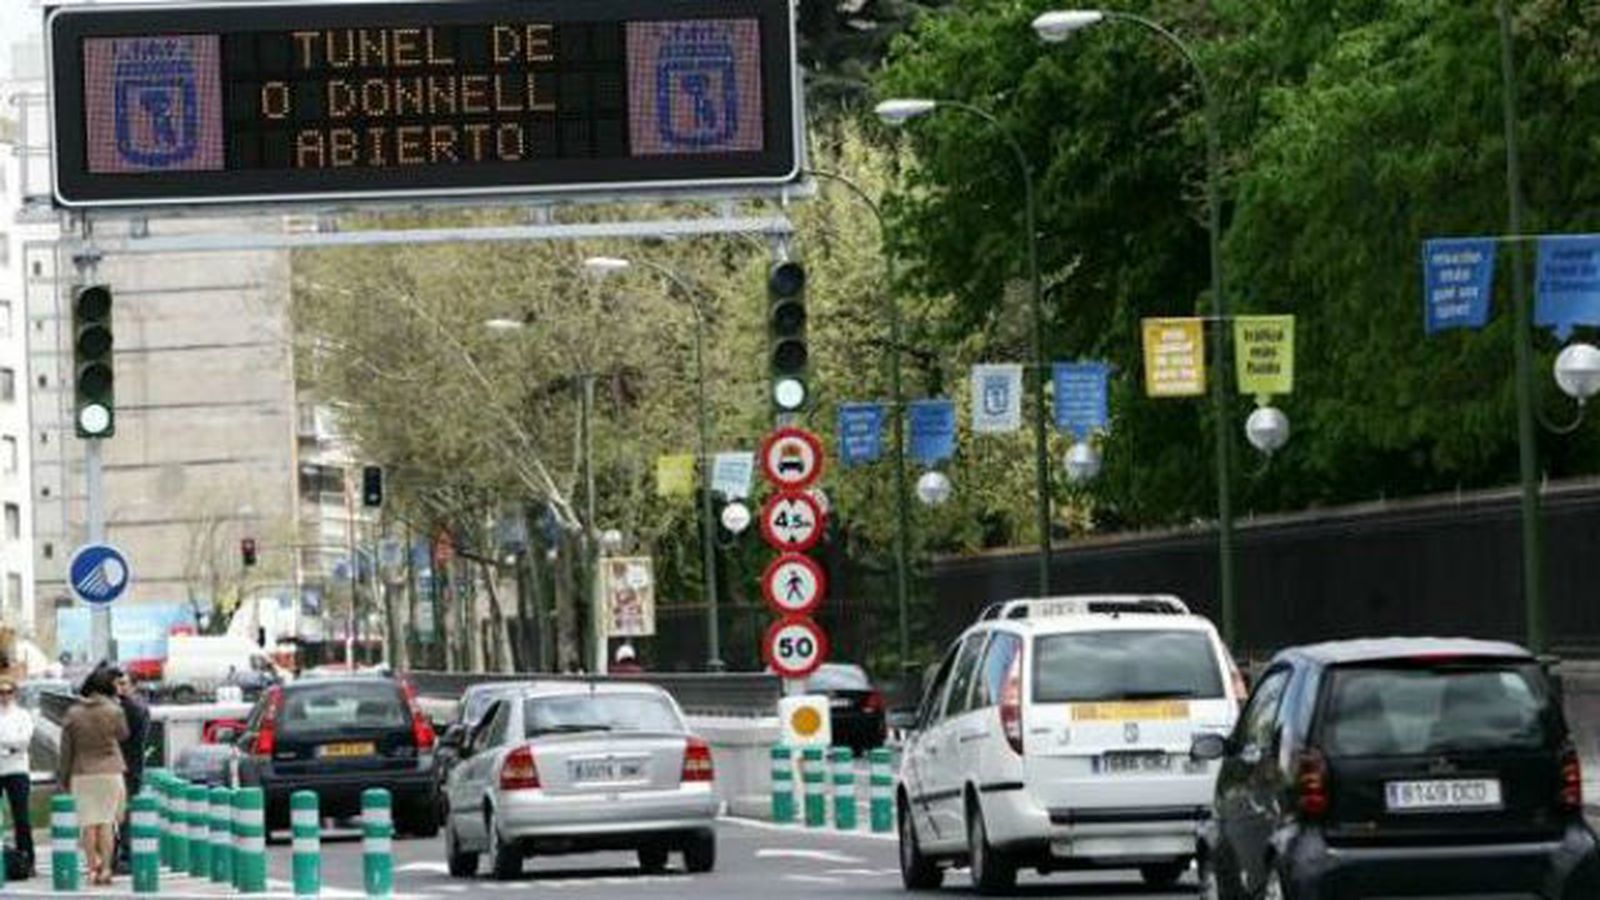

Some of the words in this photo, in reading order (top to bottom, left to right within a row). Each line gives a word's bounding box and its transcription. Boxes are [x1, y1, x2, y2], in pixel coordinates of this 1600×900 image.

[293, 28, 455, 68] TUNEL
[494, 24, 554, 62] DE
[262, 82, 289, 119] O
[328, 73, 556, 117] DONNELL
[297, 123, 525, 168] ABIERTO
[779, 637, 813, 659] 50
